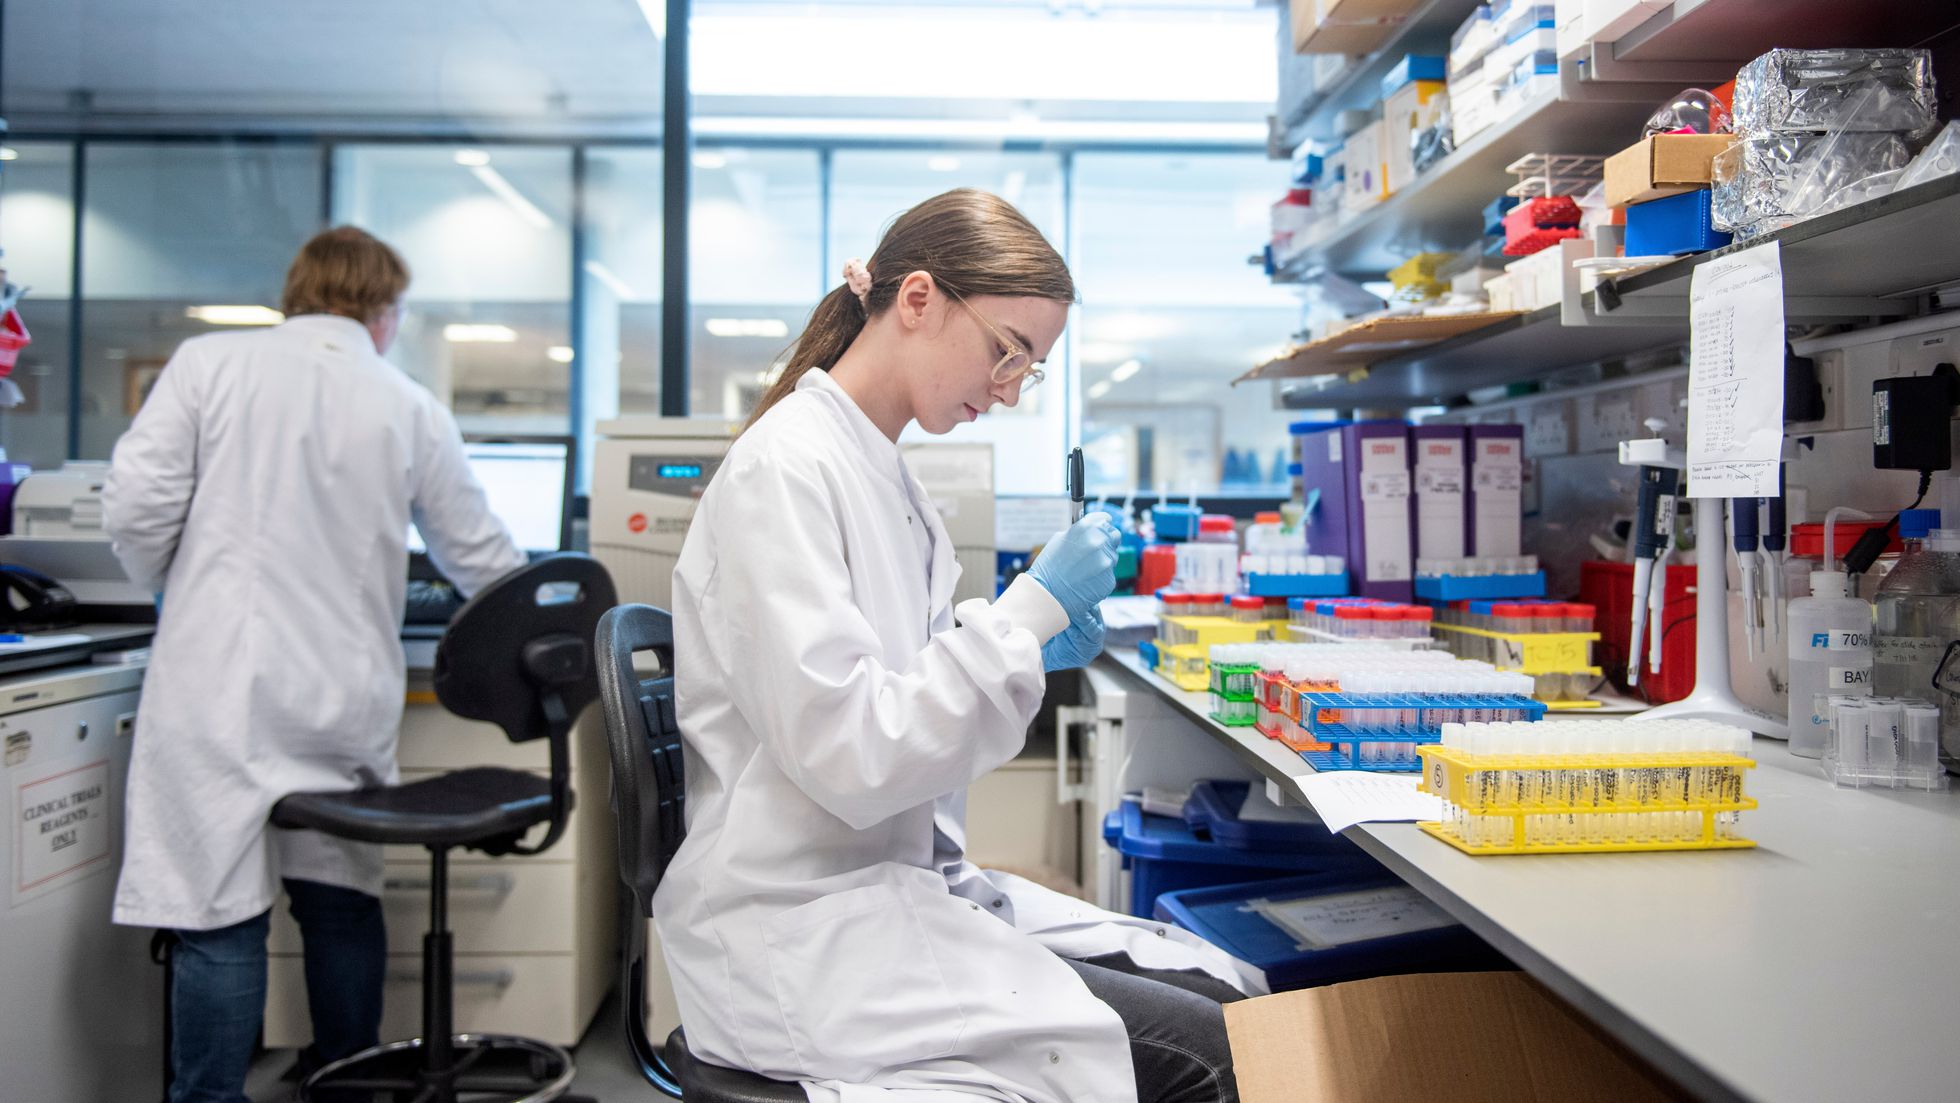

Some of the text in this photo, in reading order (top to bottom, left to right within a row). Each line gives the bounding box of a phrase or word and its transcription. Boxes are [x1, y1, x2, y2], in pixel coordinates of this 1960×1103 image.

[1842, 633, 1868, 647] 70%
[24, 786, 101, 820] CLINICAL TRIALS
[40, 808, 88, 834] REAGENTS
[51, 829, 77, 847] ONLY
